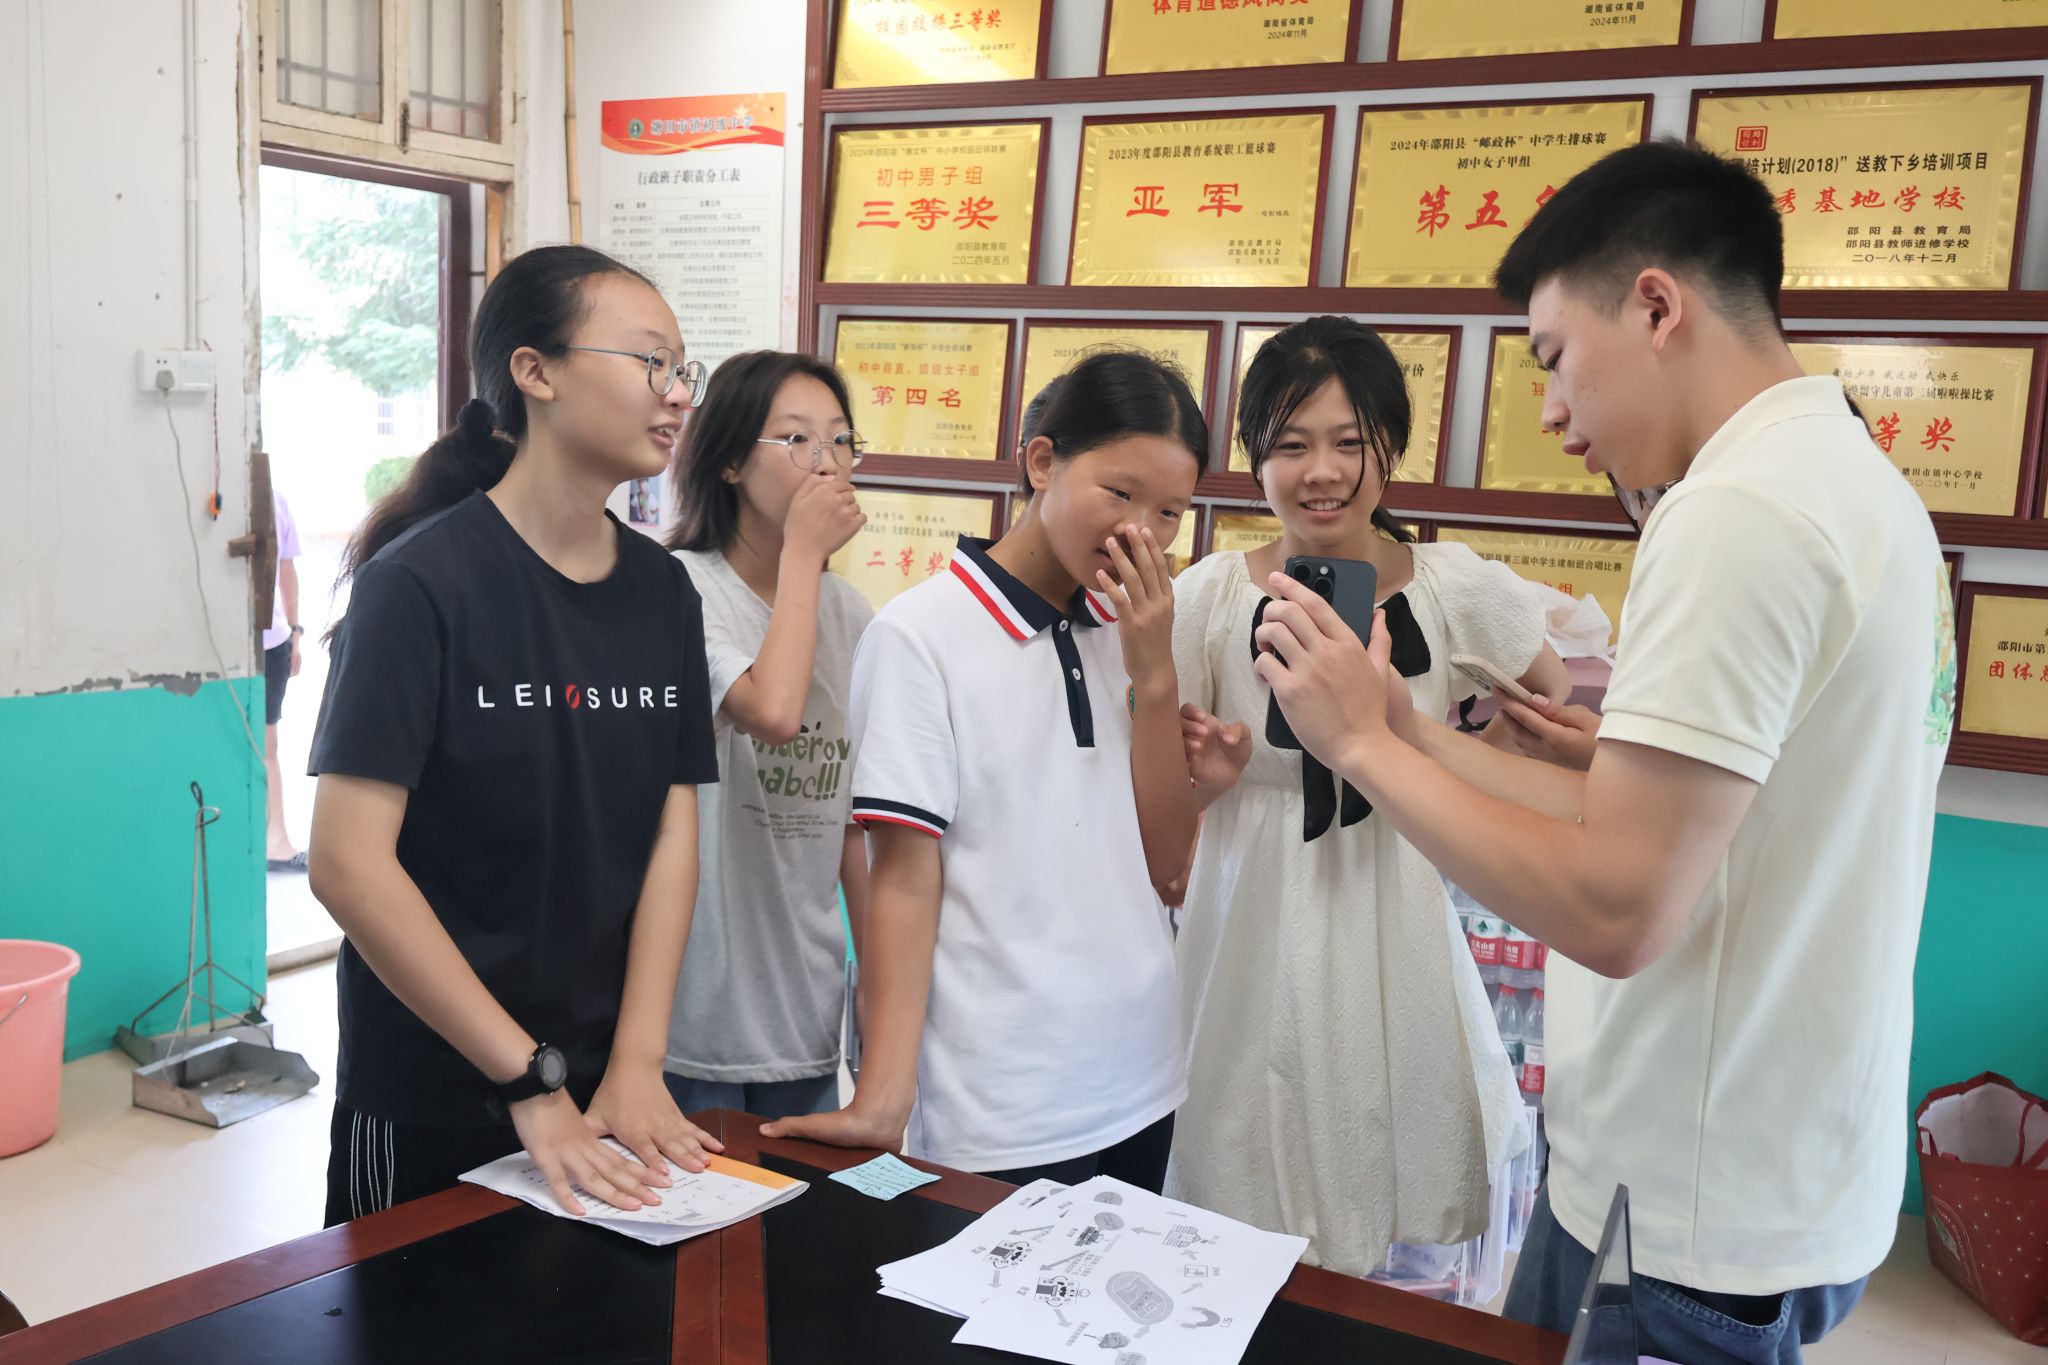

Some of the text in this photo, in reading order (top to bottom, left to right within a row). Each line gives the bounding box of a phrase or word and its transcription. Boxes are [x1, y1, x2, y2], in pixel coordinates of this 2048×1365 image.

[1590, 14, 1637, 27] 2024年11月
[1267, 28, 1308, 40] 2024年11月
[1456, 155, 1532, 170] 初中女子甲组
[637, 167, 741, 186] 行政班子职责分工表
[876, 165, 984, 188] 初中男子组
[1126, 183, 1244, 218] 亚军
[856, 195, 999, 231] 三等奖
[1847, 225, 1972, 236] 邵阳县教育局
[1845, 238, 1970, 250] 邵阳县教师进修学校
[872, 385, 961, 408] 第四名
[867, 547, 946, 577] 二等奖
